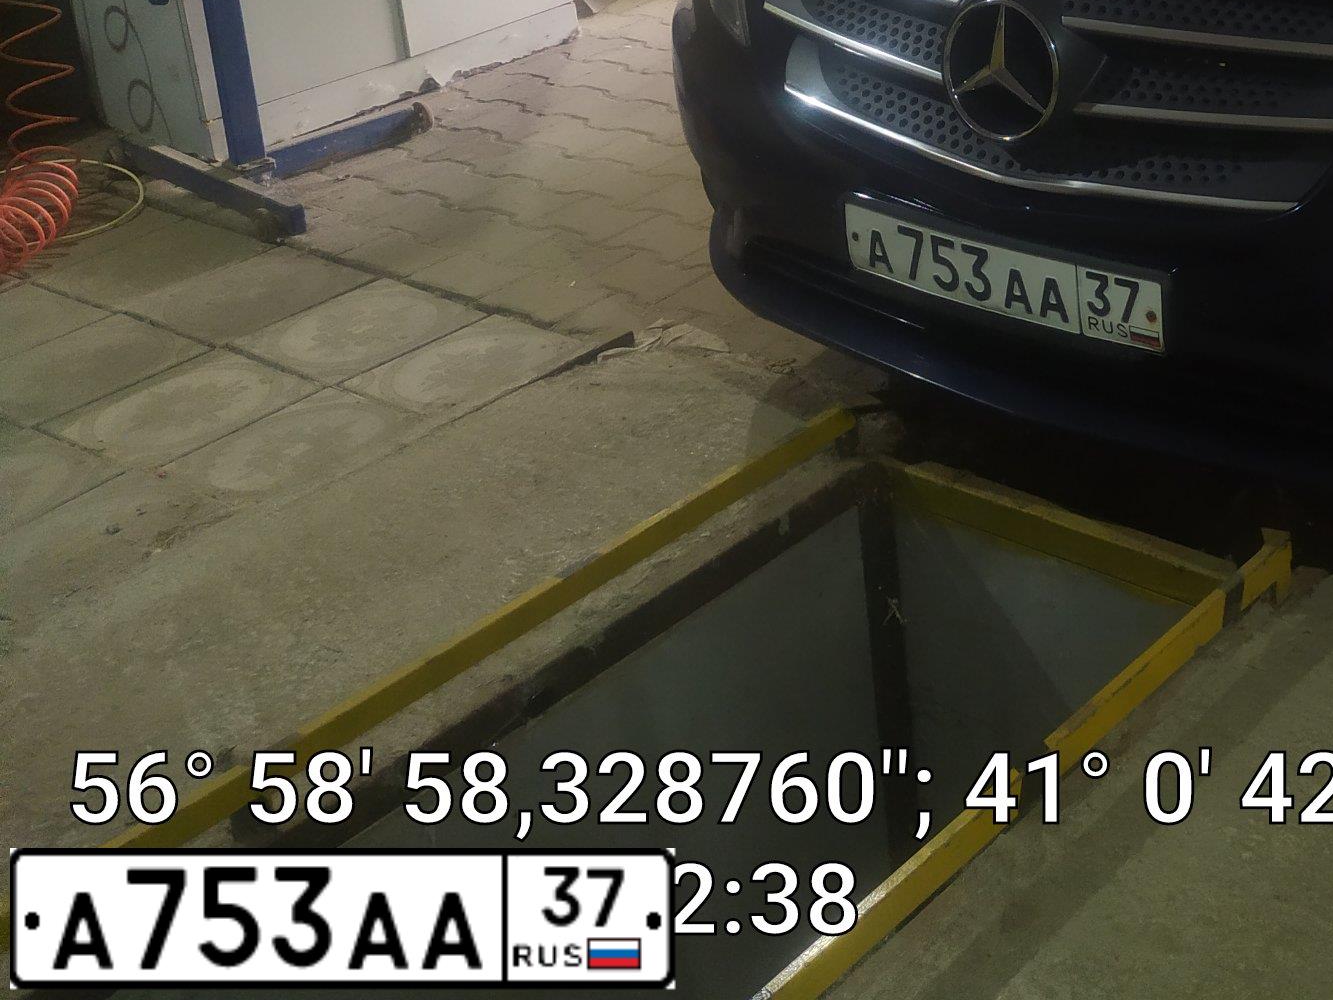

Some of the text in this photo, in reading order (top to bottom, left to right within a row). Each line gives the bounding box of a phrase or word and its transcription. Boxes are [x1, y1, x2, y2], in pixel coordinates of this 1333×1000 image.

[867, 224, 1140, 324] А753АА 37
[1087, 315, 1131, 343] RUS
